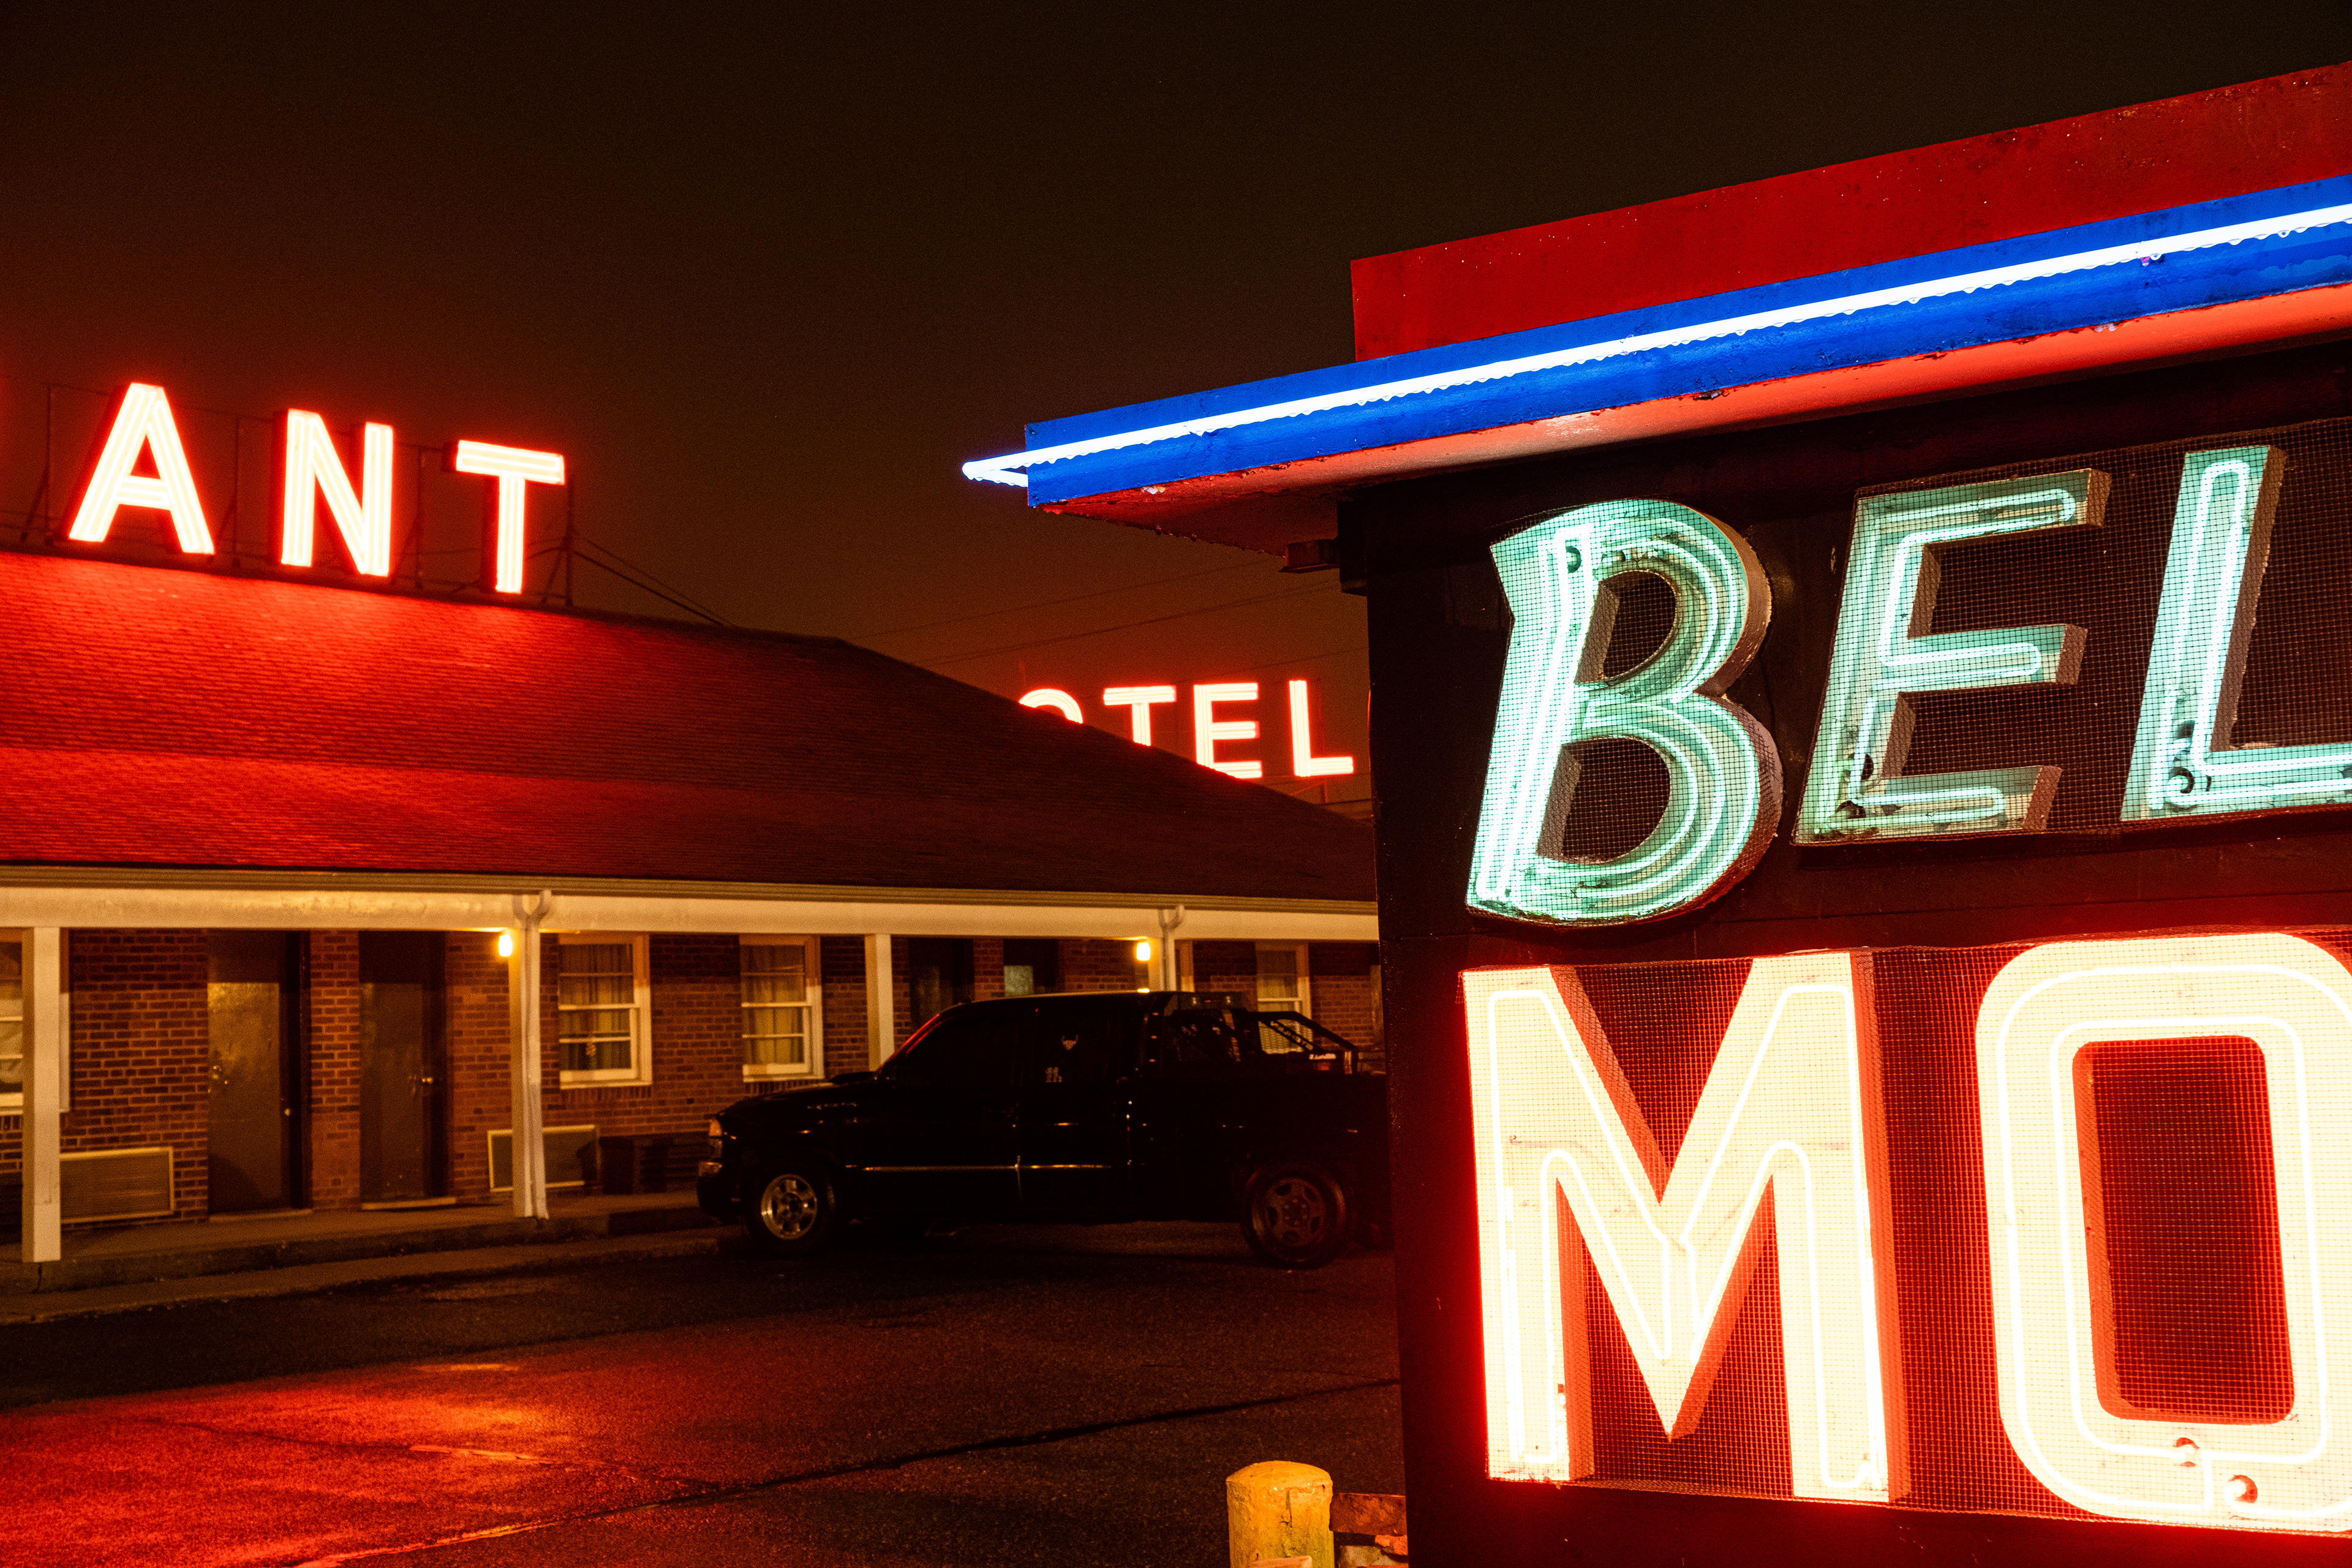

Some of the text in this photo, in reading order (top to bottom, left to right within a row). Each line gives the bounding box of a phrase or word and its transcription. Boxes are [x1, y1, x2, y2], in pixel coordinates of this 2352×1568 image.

[69, 382, 565, 594] ANT
[1466, 445, 2352, 926] BEL
[1462, 932, 2352, 1534] MO
